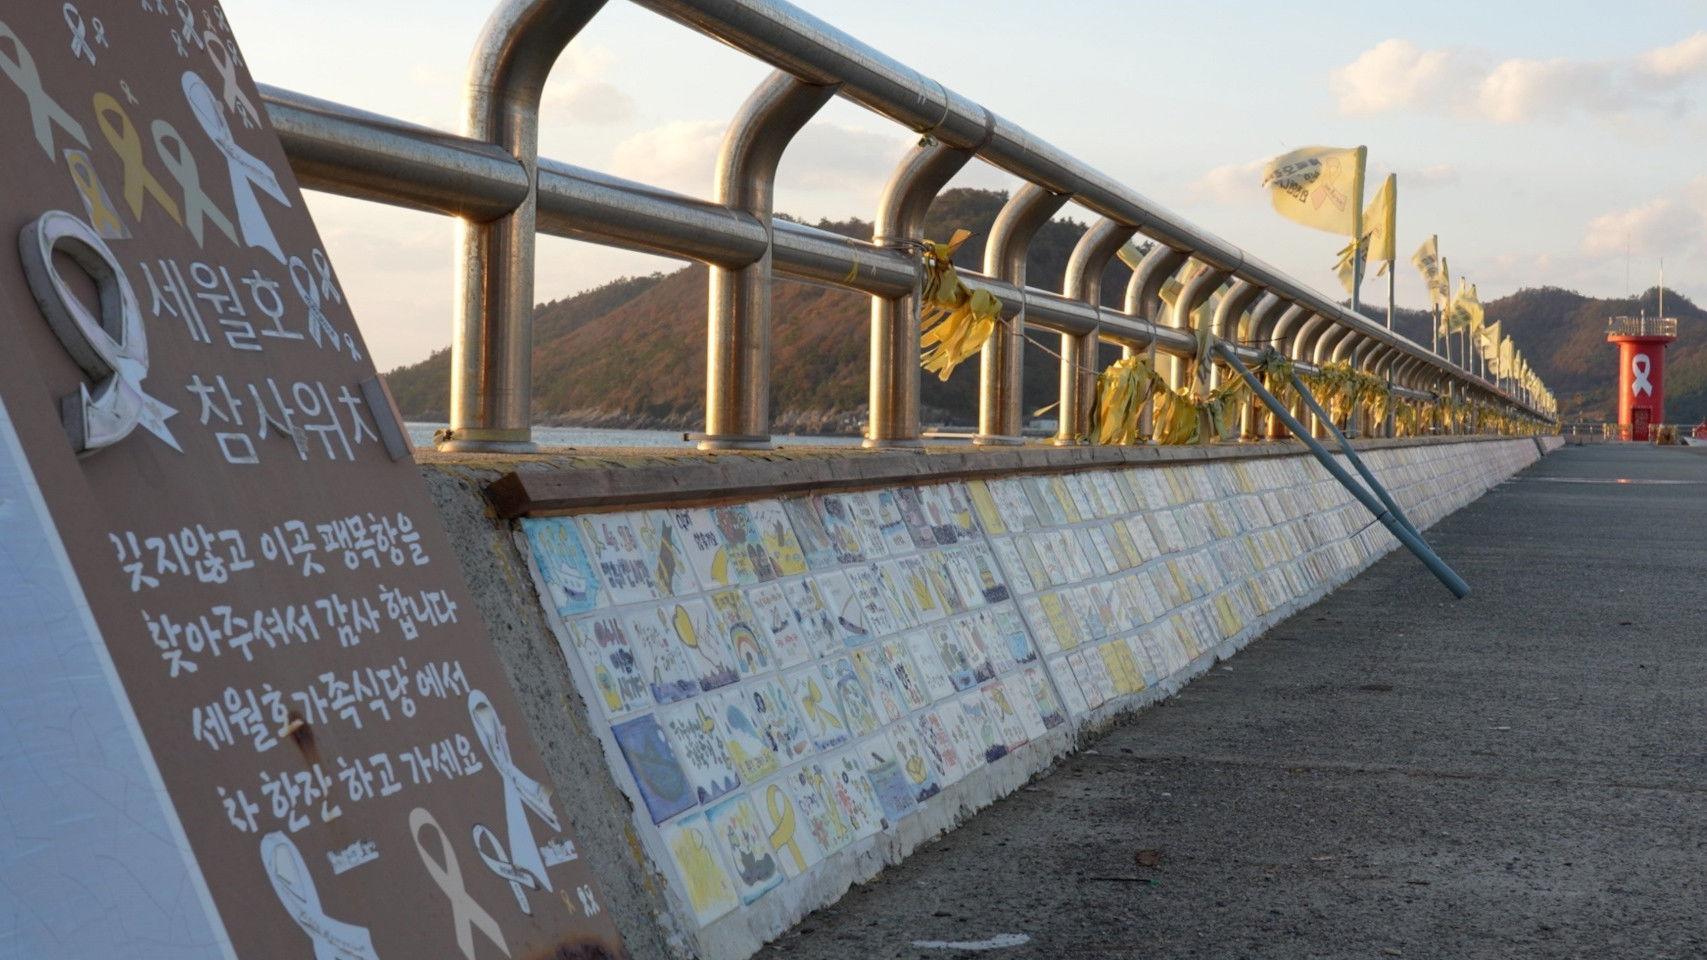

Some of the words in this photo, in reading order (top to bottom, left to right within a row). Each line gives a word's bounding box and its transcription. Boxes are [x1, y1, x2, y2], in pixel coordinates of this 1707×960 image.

[141, 259, 305, 352] 세월호
[259, 519, 327, 577] 이곳
[315, 512, 431, 570] 팽목항을
[260, 763, 343, 833] 한잔
[336, 752, 402, 802] 하고
[399, 733, 484, 783] 가세요
